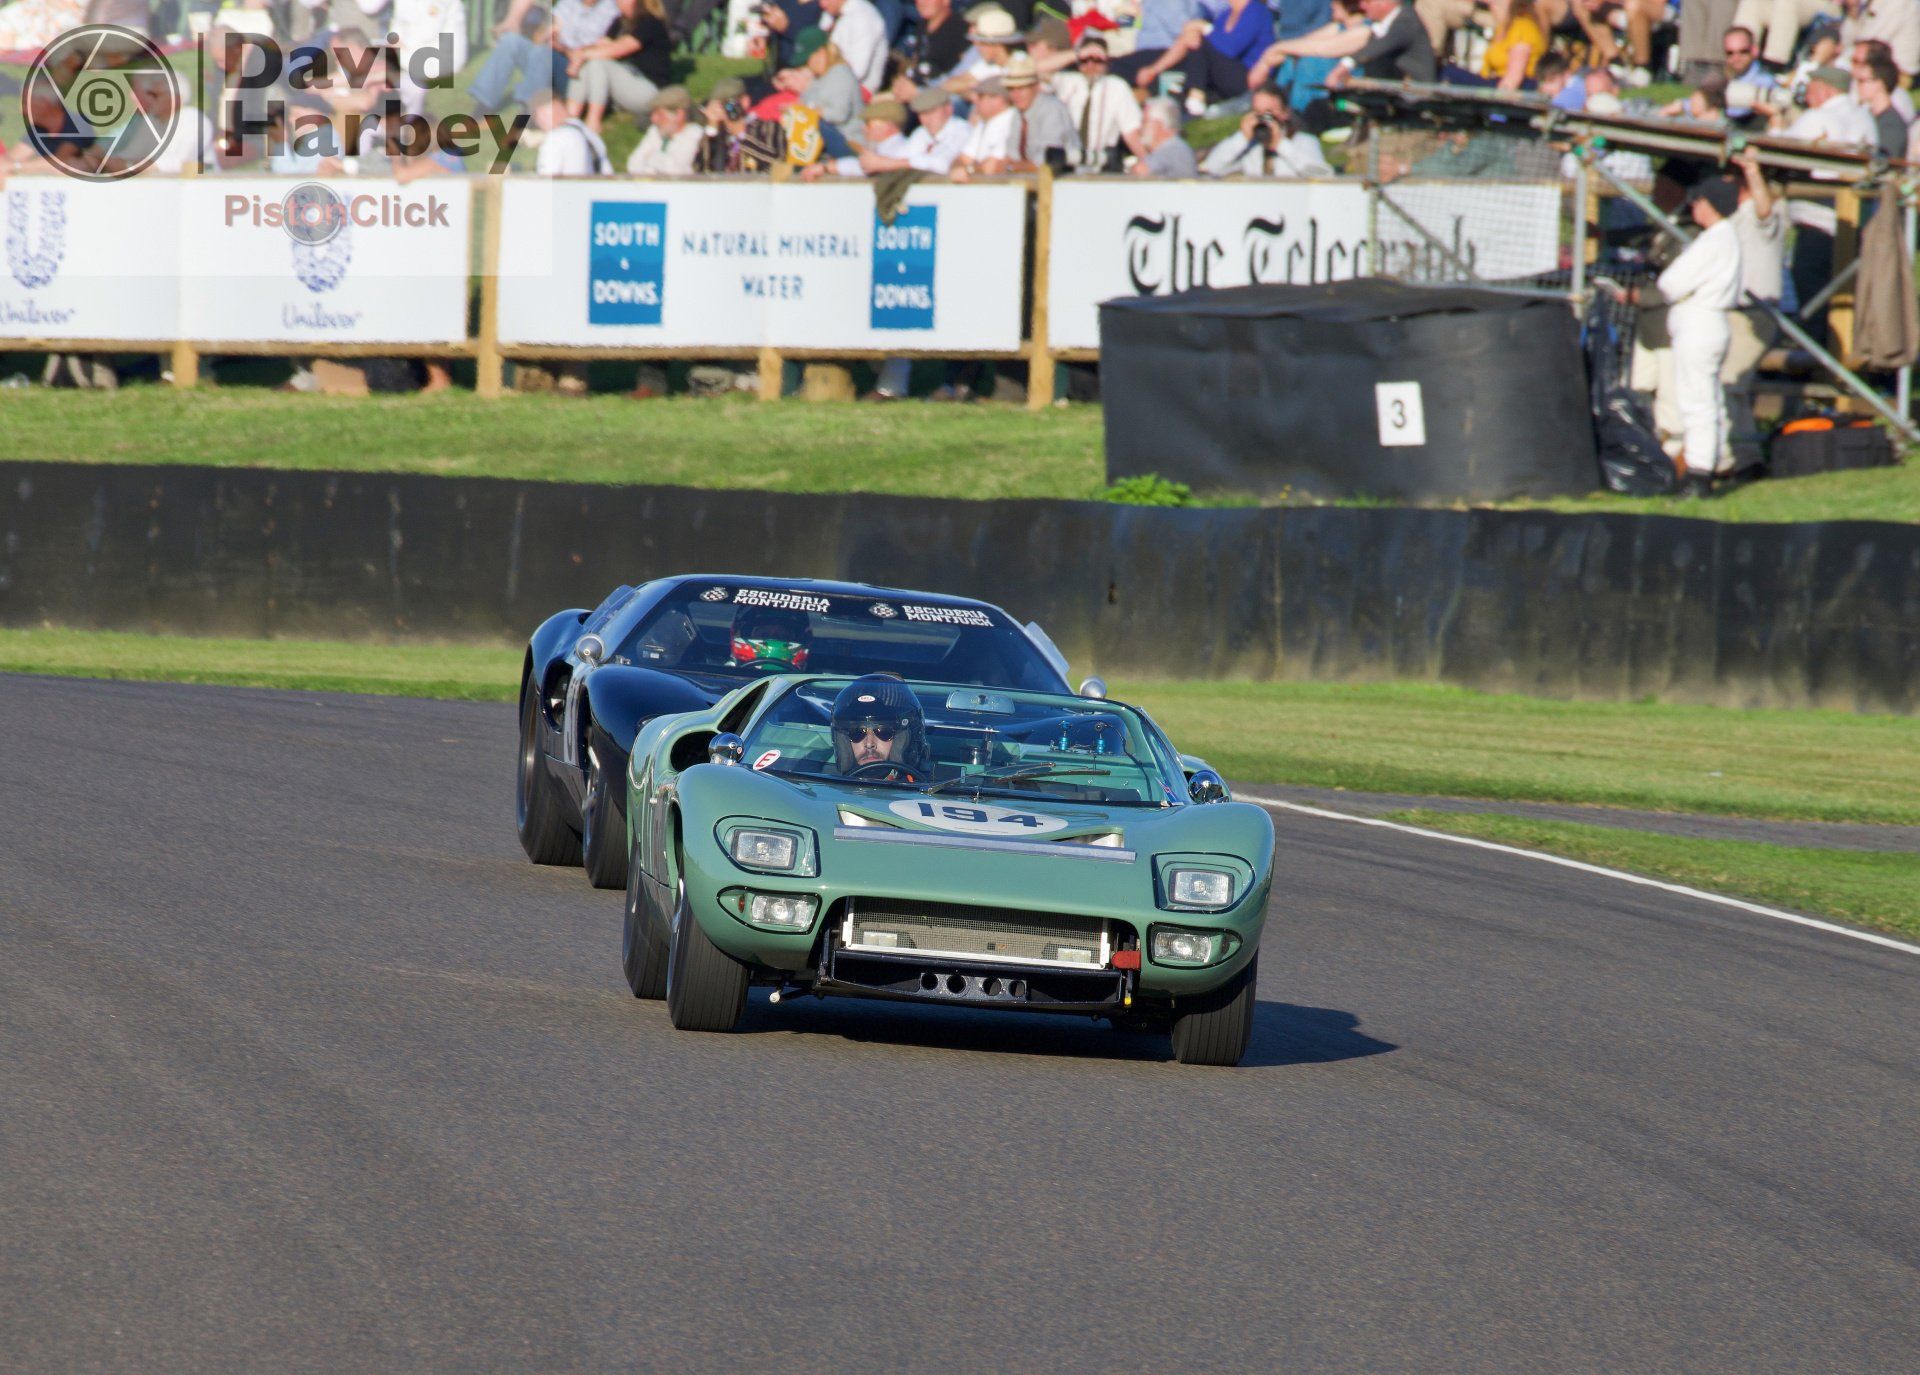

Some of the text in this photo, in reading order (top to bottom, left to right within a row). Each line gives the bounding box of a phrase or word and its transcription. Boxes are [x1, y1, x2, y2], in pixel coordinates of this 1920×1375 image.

[594, 221, 661, 247] SOUTH
[682, 230, 860, 258] NATURAL MINERAL
[876, 224, 932, 250] SOUTH
[1125, 213, 1224, 297] The
[593, 279, 660, 306] DOWNS
[741, 274, 804, 299] WATER
[1391, 398, 1407, 429] 3
[732, 596, 828, 613] MONTJUICH
[737, 589, 830, 606] ESCUDERIA
[902, 605, 989, 619] ESCUDERIA
[905, 612, 995, 627] MONTJUICH
[755, 752, 777, 768] E
[917, 802, 1044, 828] 194
